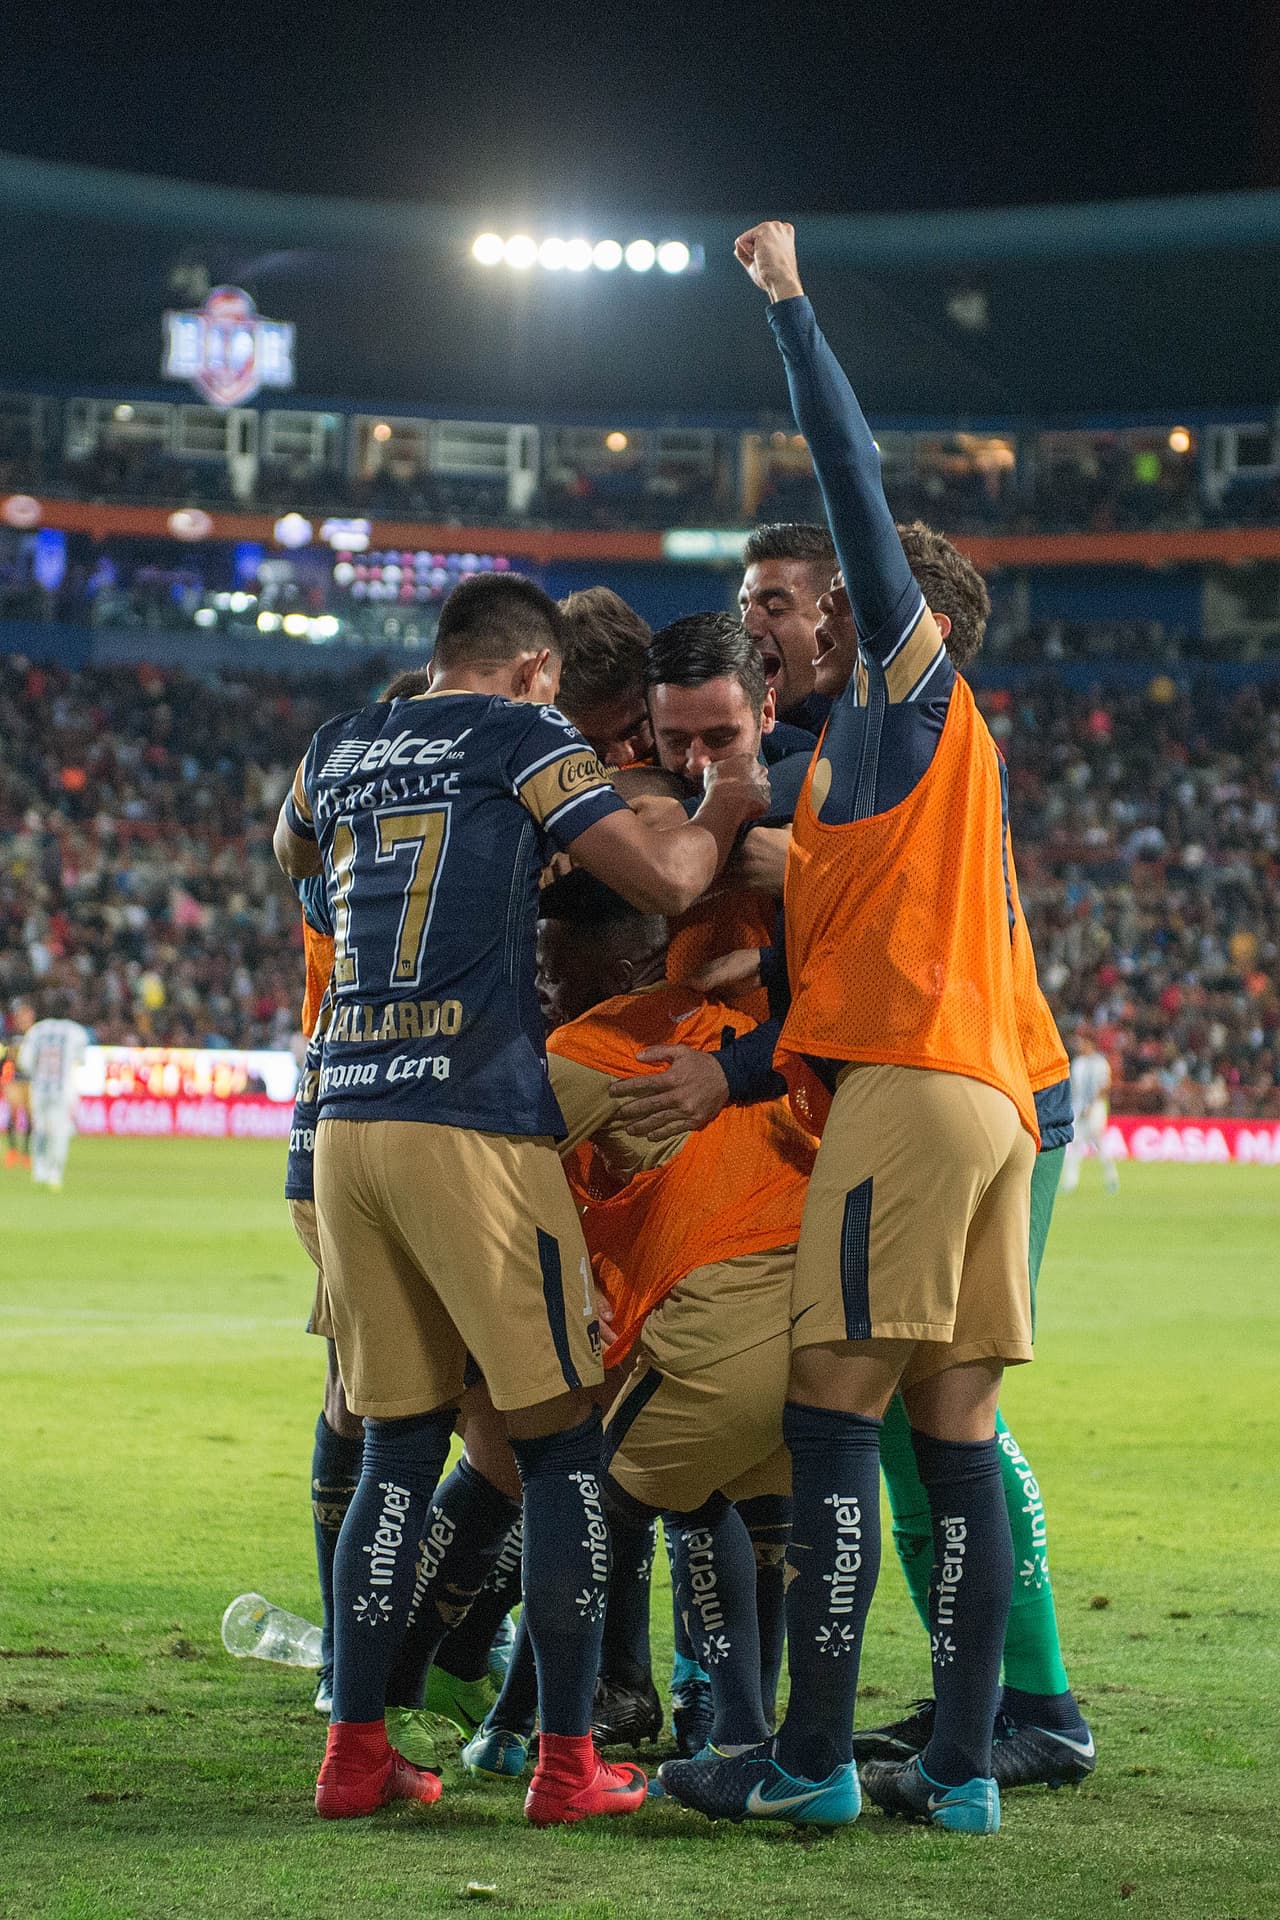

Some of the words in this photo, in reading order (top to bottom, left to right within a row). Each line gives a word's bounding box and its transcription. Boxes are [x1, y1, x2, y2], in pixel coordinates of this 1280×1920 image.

[329, 801, 453, 993] 17
[328, 999, 464, 1042] ALLARDO
[319, 1063, 379, 1095] rona
[1130, 1126, 1231, 1161] CASA
[362, 1481, 412, 1586] interjet
[569, 1470, 608, 1582] interjet
[823, 1493, 862, 1614] interjet
[935, 1515, 966, 1625] interjet
